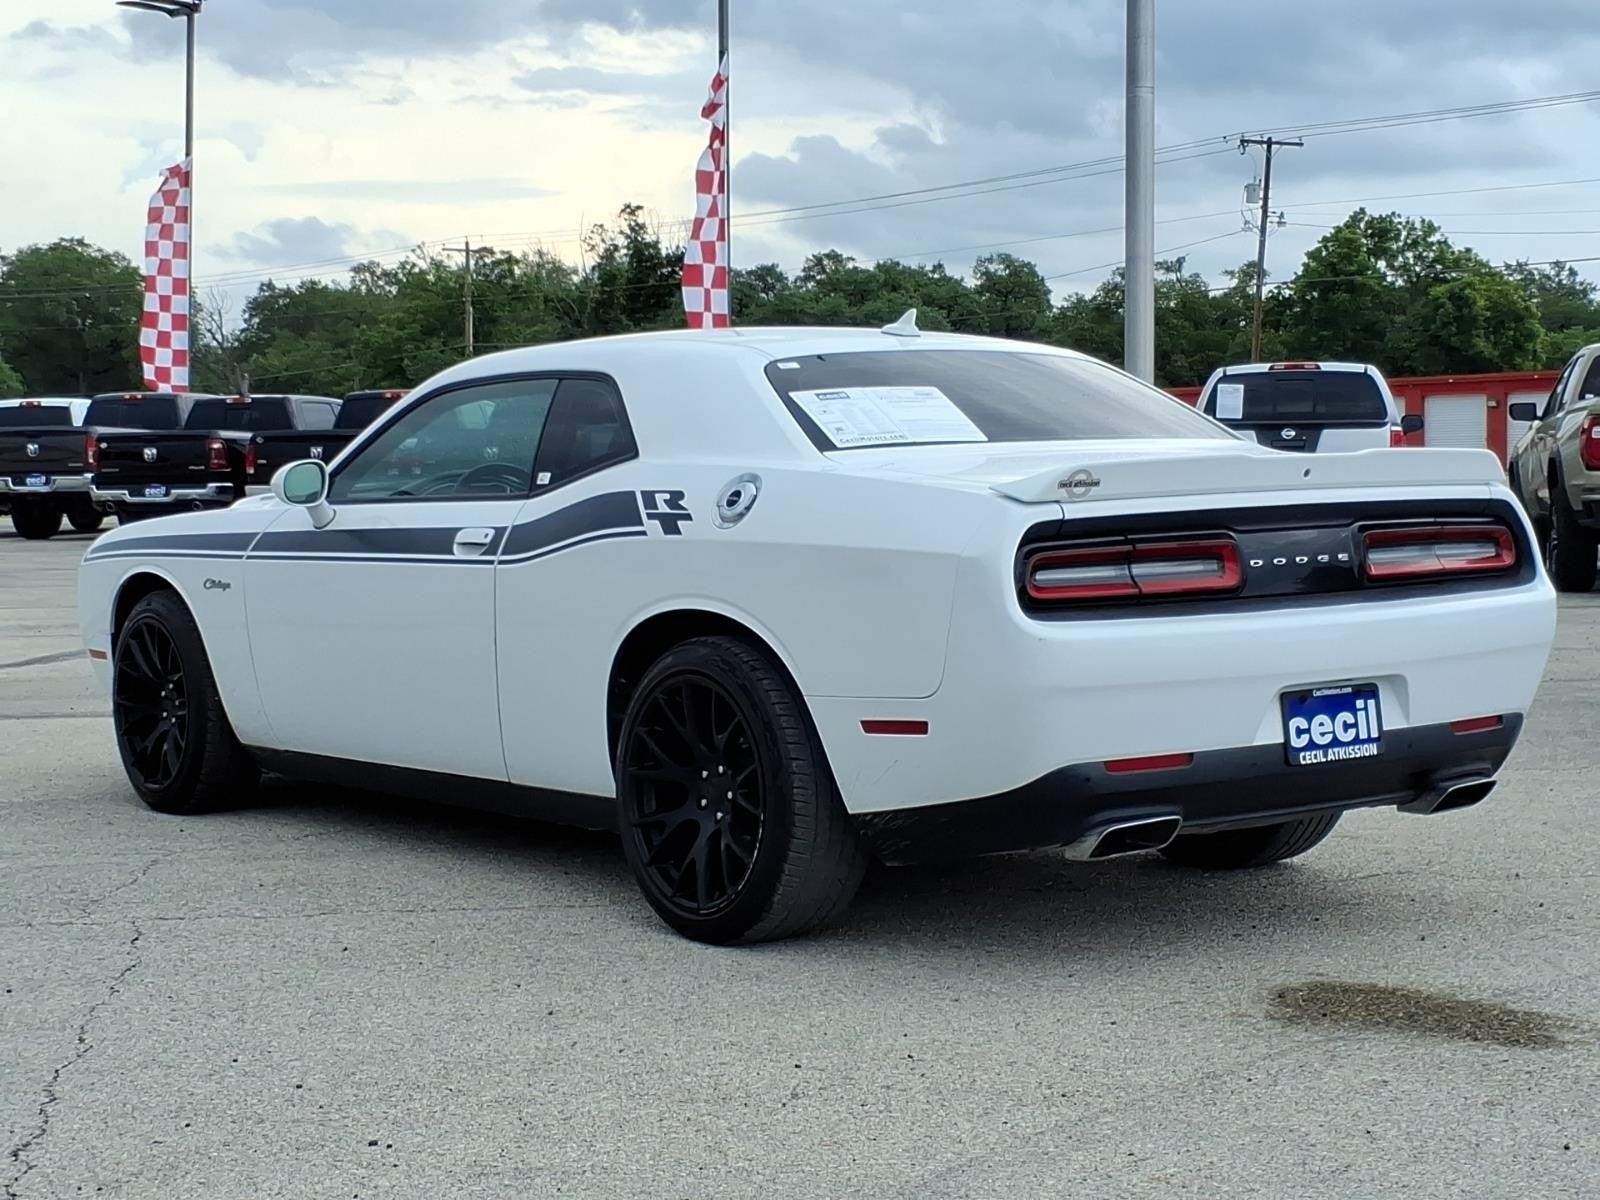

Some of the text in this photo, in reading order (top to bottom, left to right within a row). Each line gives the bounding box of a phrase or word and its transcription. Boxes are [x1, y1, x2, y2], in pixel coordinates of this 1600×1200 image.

[1249, 553, 1350, 567] DODGE
[1288, 698, 1379, 748] cecil
[1299, 743, 1378, 765] CECIL ATKISSION
